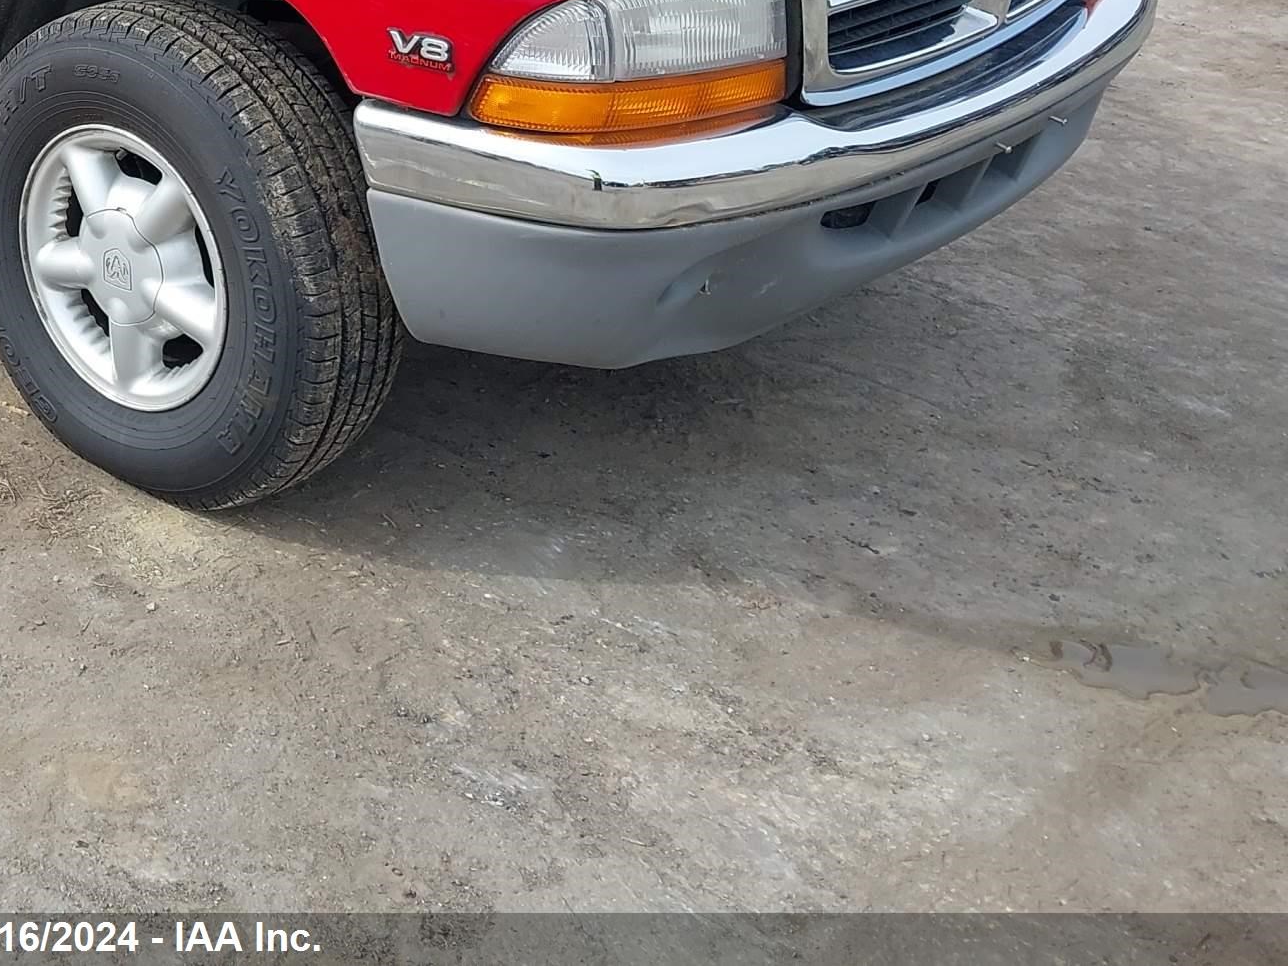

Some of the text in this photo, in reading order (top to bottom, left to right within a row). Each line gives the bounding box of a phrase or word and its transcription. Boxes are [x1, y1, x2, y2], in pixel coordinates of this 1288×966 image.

[388, 29, 450, 63] V8
[389, 50, 452, 72] MAGNUM
[215, 166, 277, 455] YOKOHAMA
